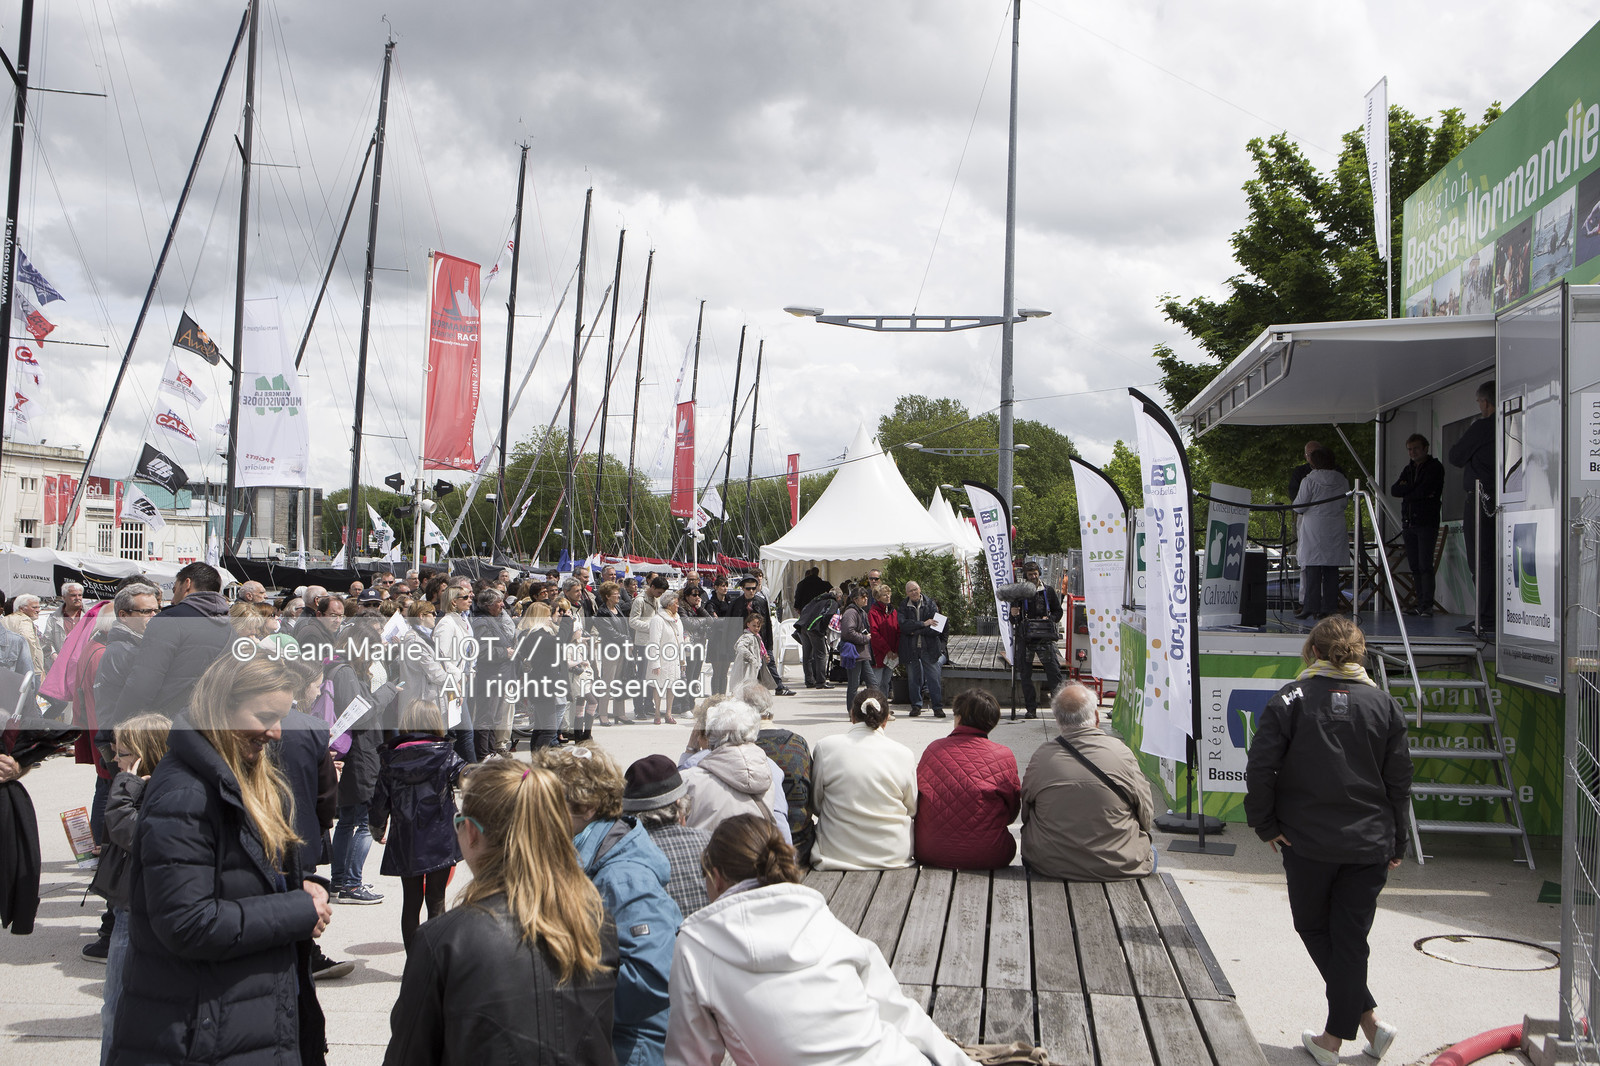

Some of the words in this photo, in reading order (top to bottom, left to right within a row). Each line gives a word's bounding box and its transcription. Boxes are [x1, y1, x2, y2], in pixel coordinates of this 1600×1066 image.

[1406, 102, 1600, 291] Basse-Normandie
[1417, 171, 1469, 231] Région
[1, 217, 14, 305] www.renostyle.fr
[1203, 584, 1239, 606] Calvados
[1208, 688, 1225, 761] Région
